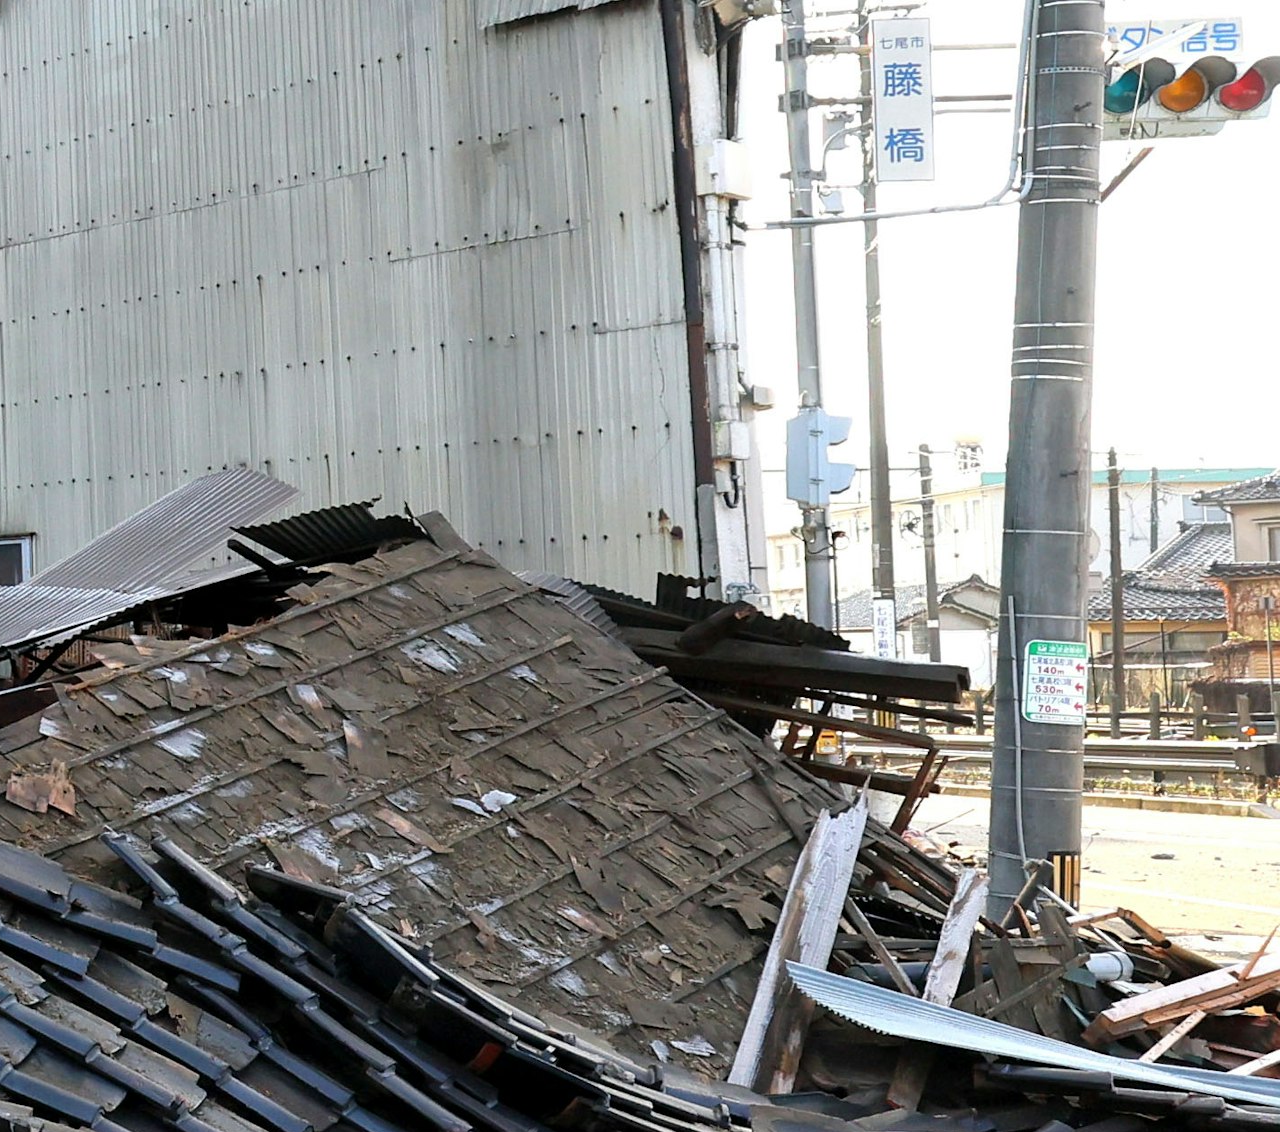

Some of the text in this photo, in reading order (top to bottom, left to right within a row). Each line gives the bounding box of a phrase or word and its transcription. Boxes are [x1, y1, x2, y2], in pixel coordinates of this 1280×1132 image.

[879, 36, 924, 50] 七尾市
[883, 62, 925, 163] 藤橋
[1037, 666, 1064, 675] 140m
[1035, 685, 1064, 694] 530m
[1037, 704, 1060, 713] 70m
